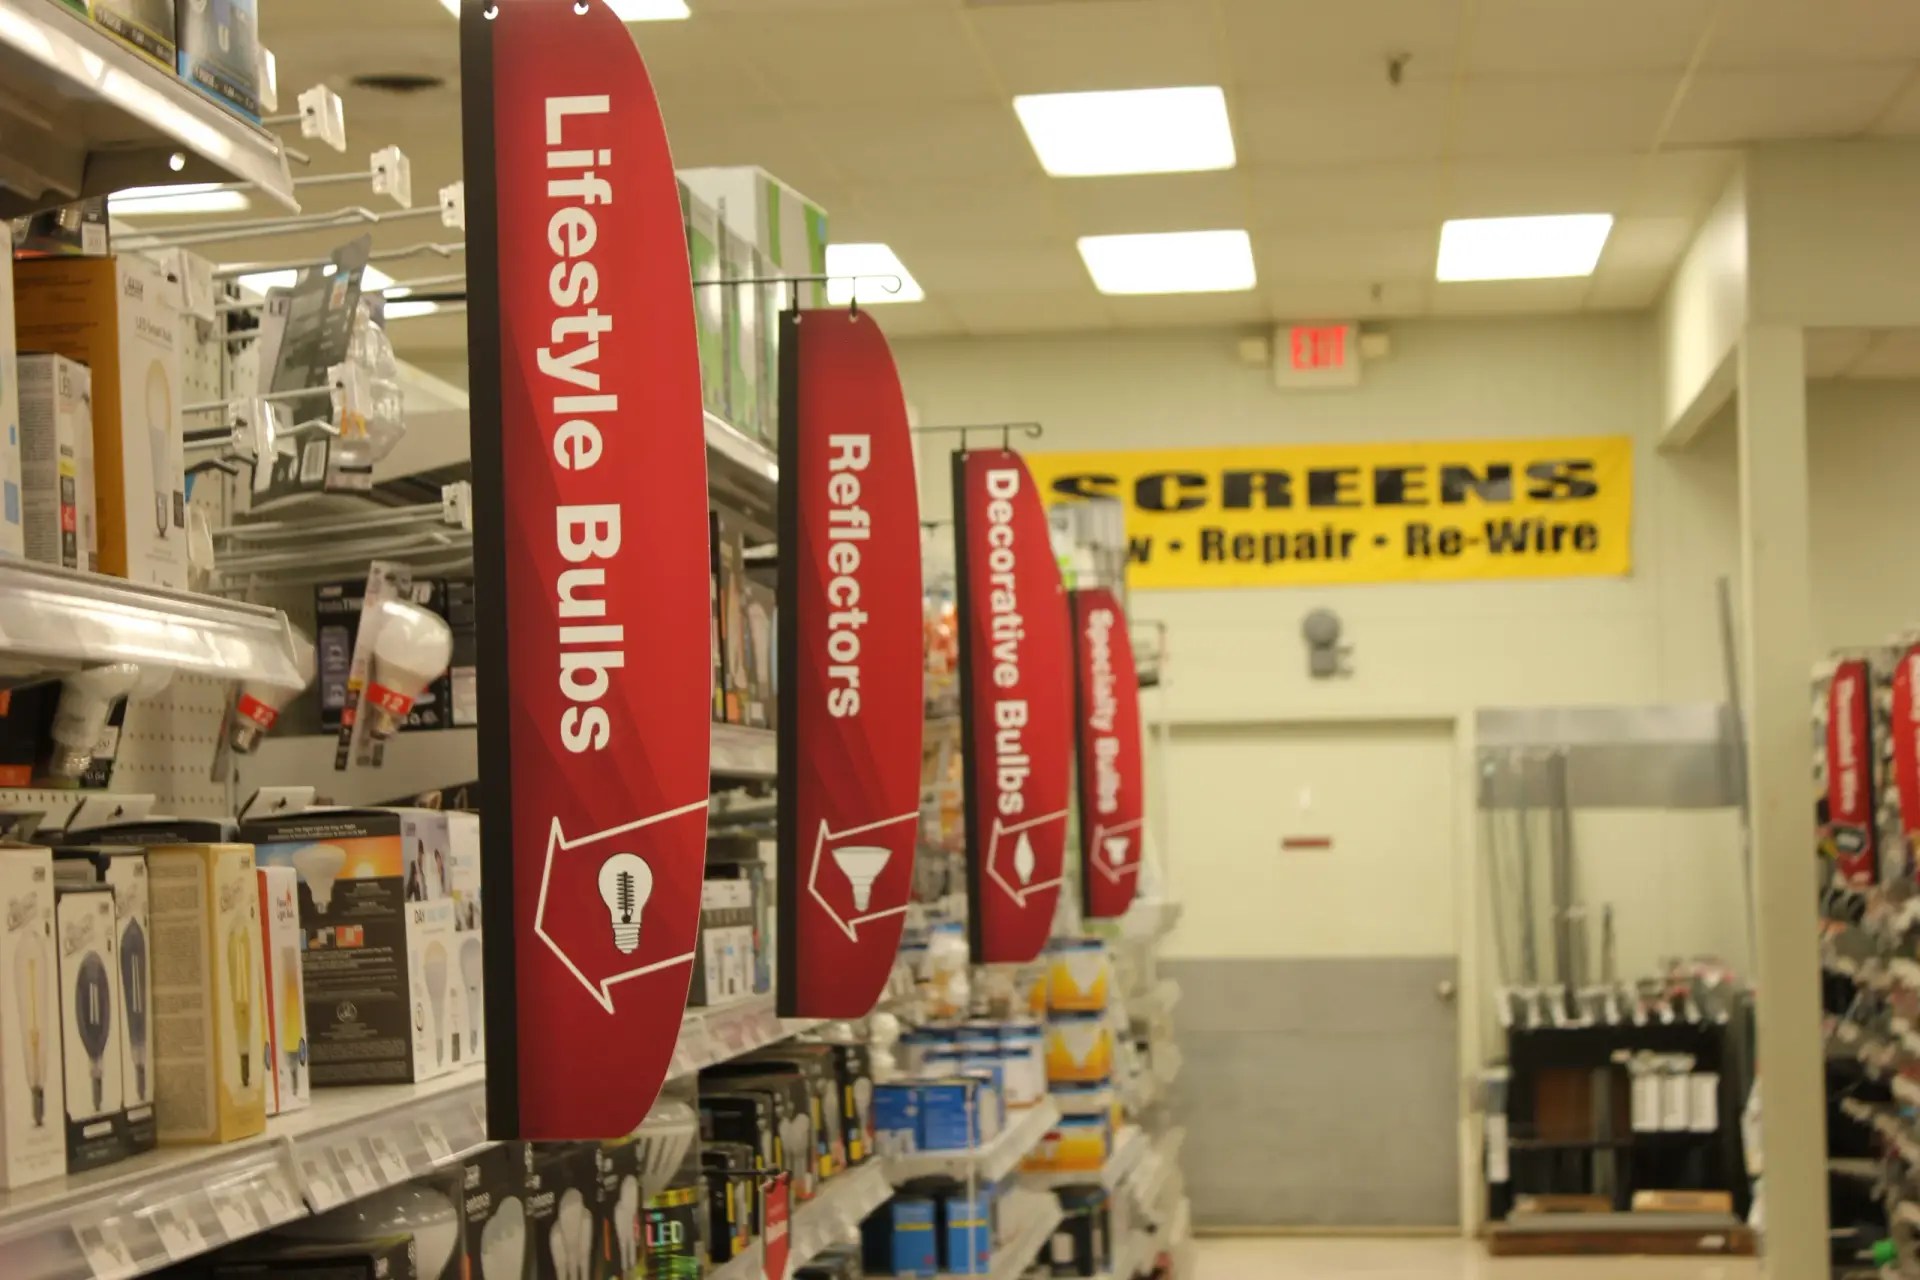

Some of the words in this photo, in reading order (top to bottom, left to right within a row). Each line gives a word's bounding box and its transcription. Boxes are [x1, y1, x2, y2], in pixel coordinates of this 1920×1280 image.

[537, 95, 618, 470] Lifestyle
[1290, 325, 1348, 371] EXIT
[1051, 459, 1600, 514] SCREENS
[1199, 526, 1357, 565] Repair
[1405, 521, 1598, 557] Re-Wire
[556, 503, 625, 753] Bulbs
[827, 433, 871, 718] Reflectors
[985, 468, 1026, 688] Decorative
[994, 699, 1031, 815] Bulbs
[1094, 736, 1121, 814] Bulbs
